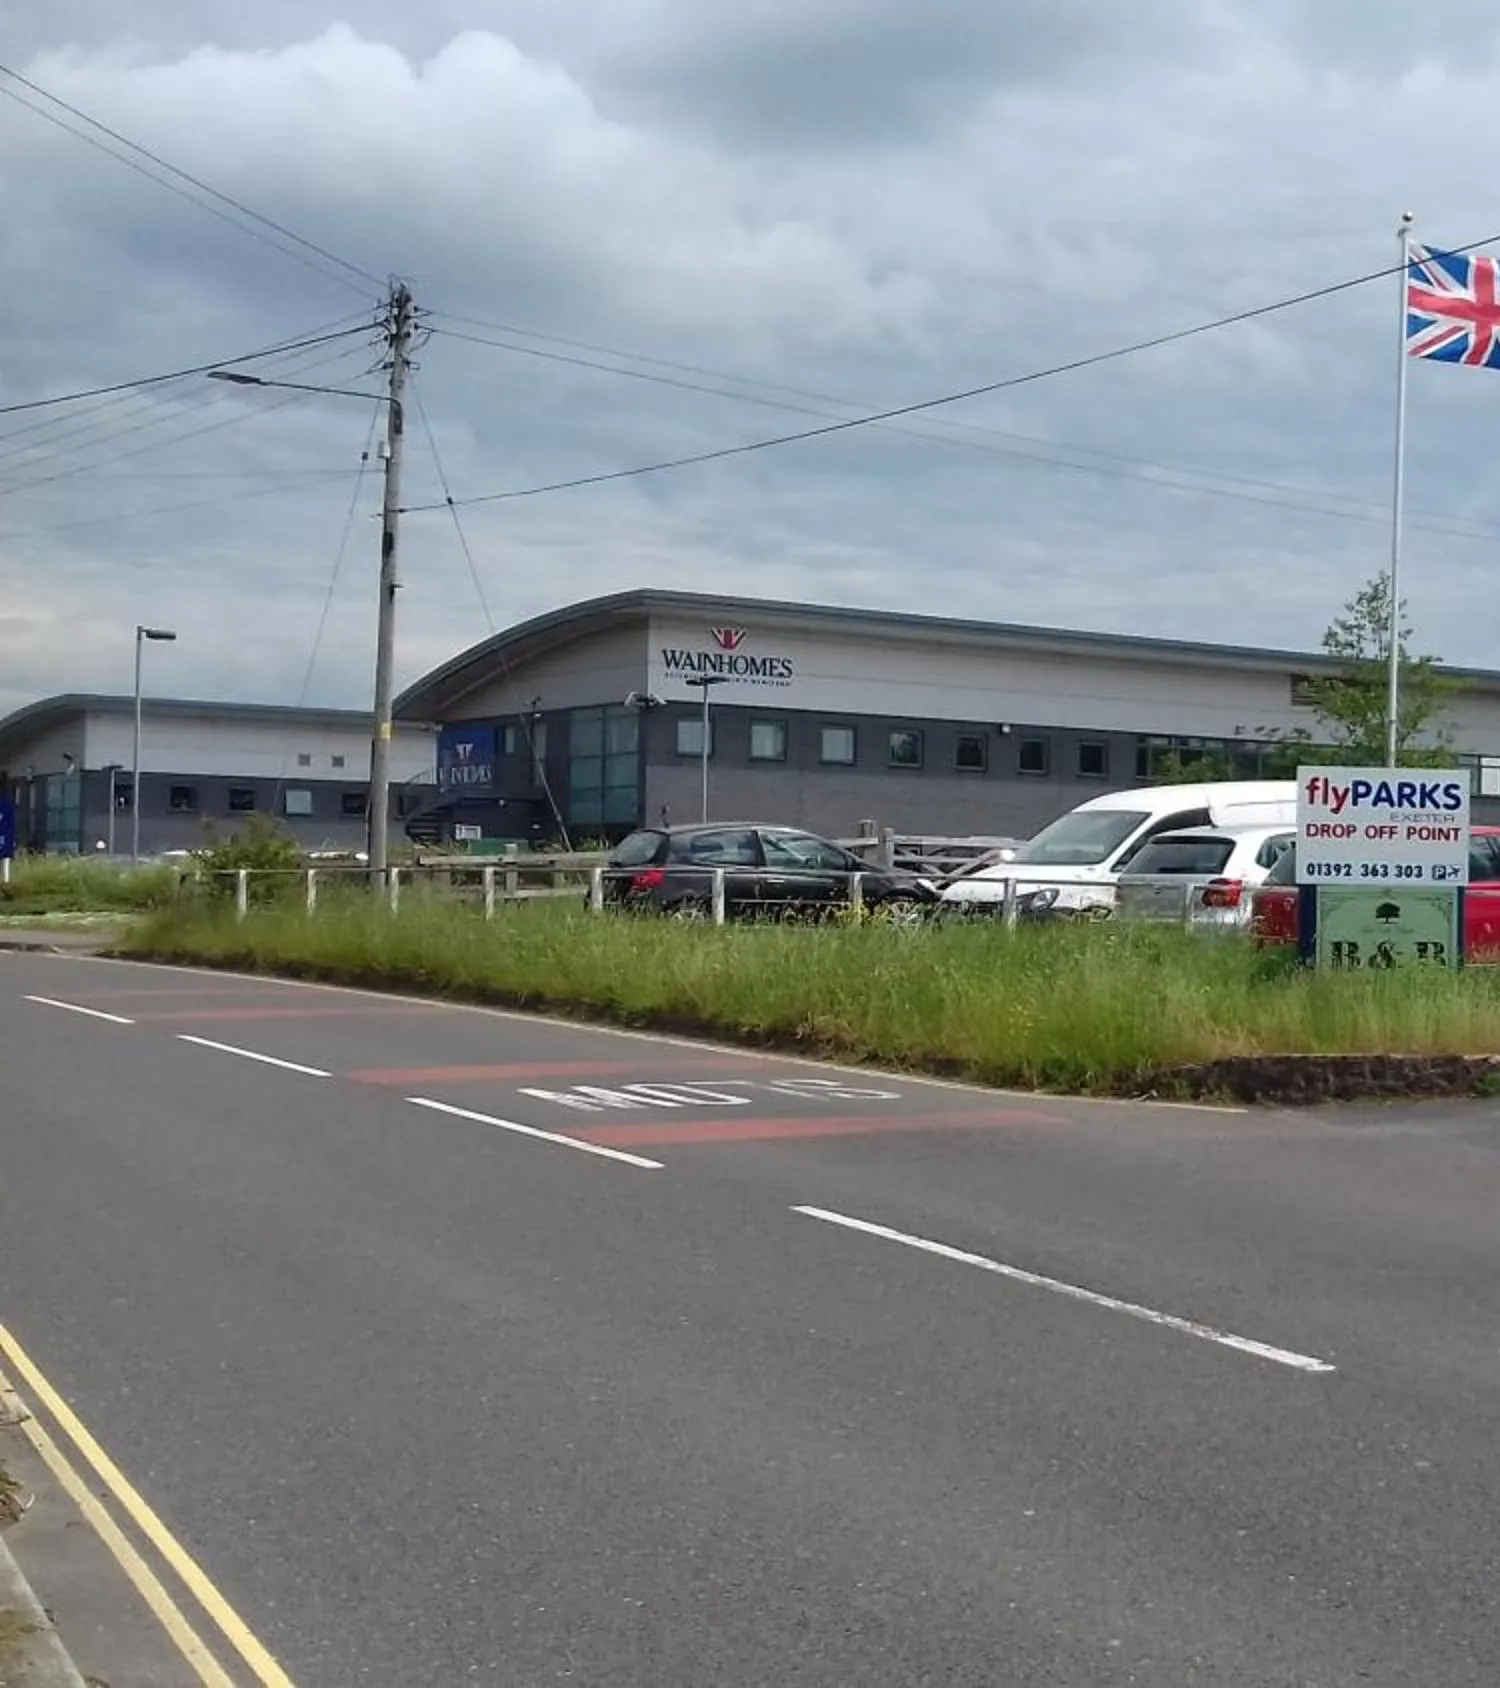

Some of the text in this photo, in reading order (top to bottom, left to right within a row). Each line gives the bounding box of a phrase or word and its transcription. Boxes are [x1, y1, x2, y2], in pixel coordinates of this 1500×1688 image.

[662, 649, 793, 678] WAINHOMES
[1305, 777, 1462, 814] flyPARKS
[1305, 823, 1462, 841] DROP OFF POINT
[1305, 863, 1353, 877] 01392
[1360, 864, 1389, 877] 363
[1393, 865, 1423, 878] 303
